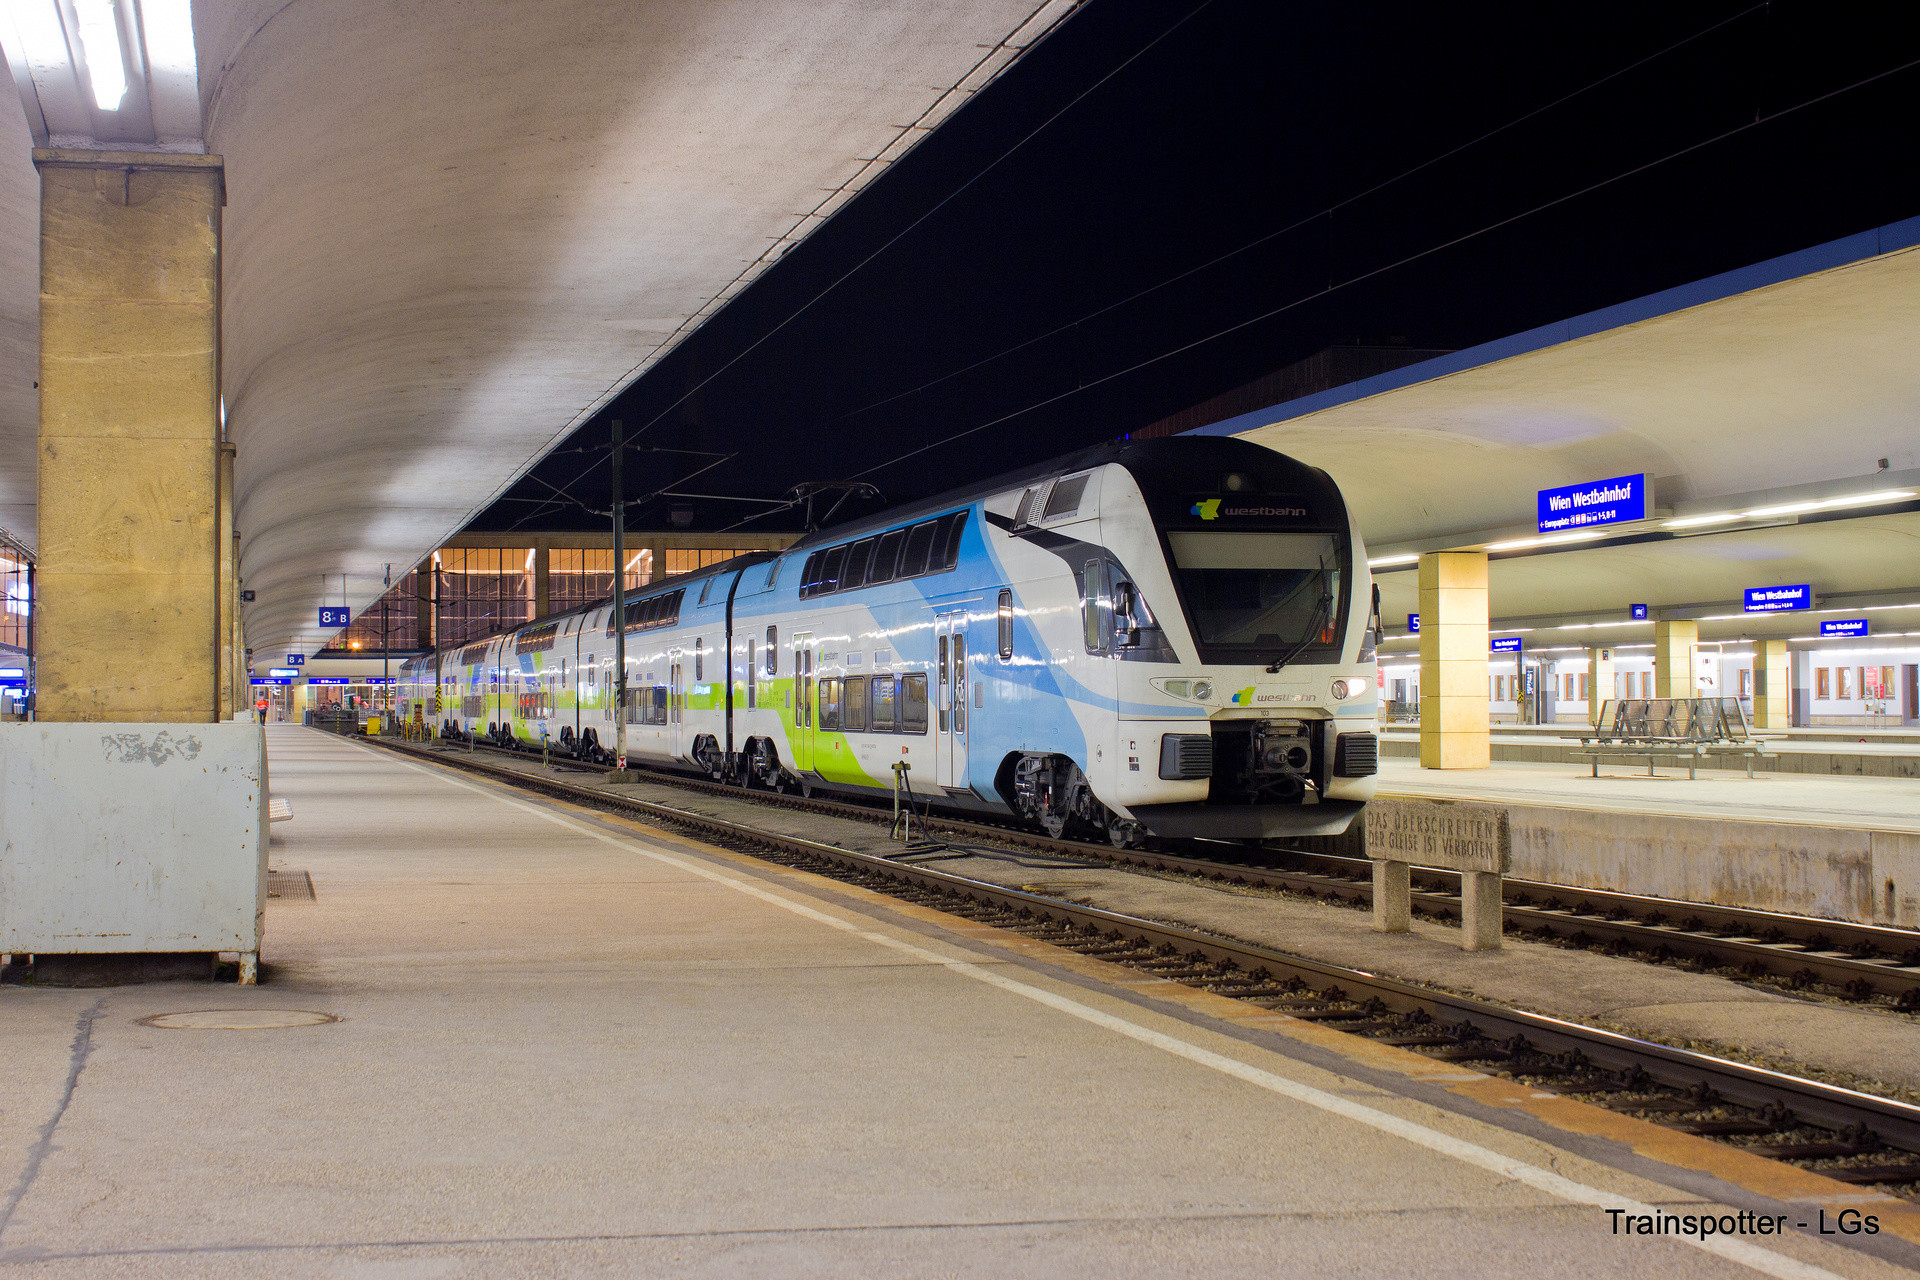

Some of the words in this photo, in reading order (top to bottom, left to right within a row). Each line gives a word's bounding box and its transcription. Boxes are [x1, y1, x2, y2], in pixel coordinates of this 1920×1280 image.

[1549, 495, 1571, 511] Wien
[1573, 482, 1631, 507] Westbahnhof
[1224, 506, 1307, 516] westbahn
[322, 611, 332, 623] 8
[340, 614, 347, 623] B
[1412, 616, 1420, 630] 5
[1368, 810, 1387, 829] DAS
[1395, 810, 1493, 839] ÜBERSCHREITEN
[1368, 831, 1385, 848] DER
[1389, 831, 1417, 852] GLEISE
[1424, 835, 1437, 854] IST
[1443, 837, 1493, 860] VERBOTEN
